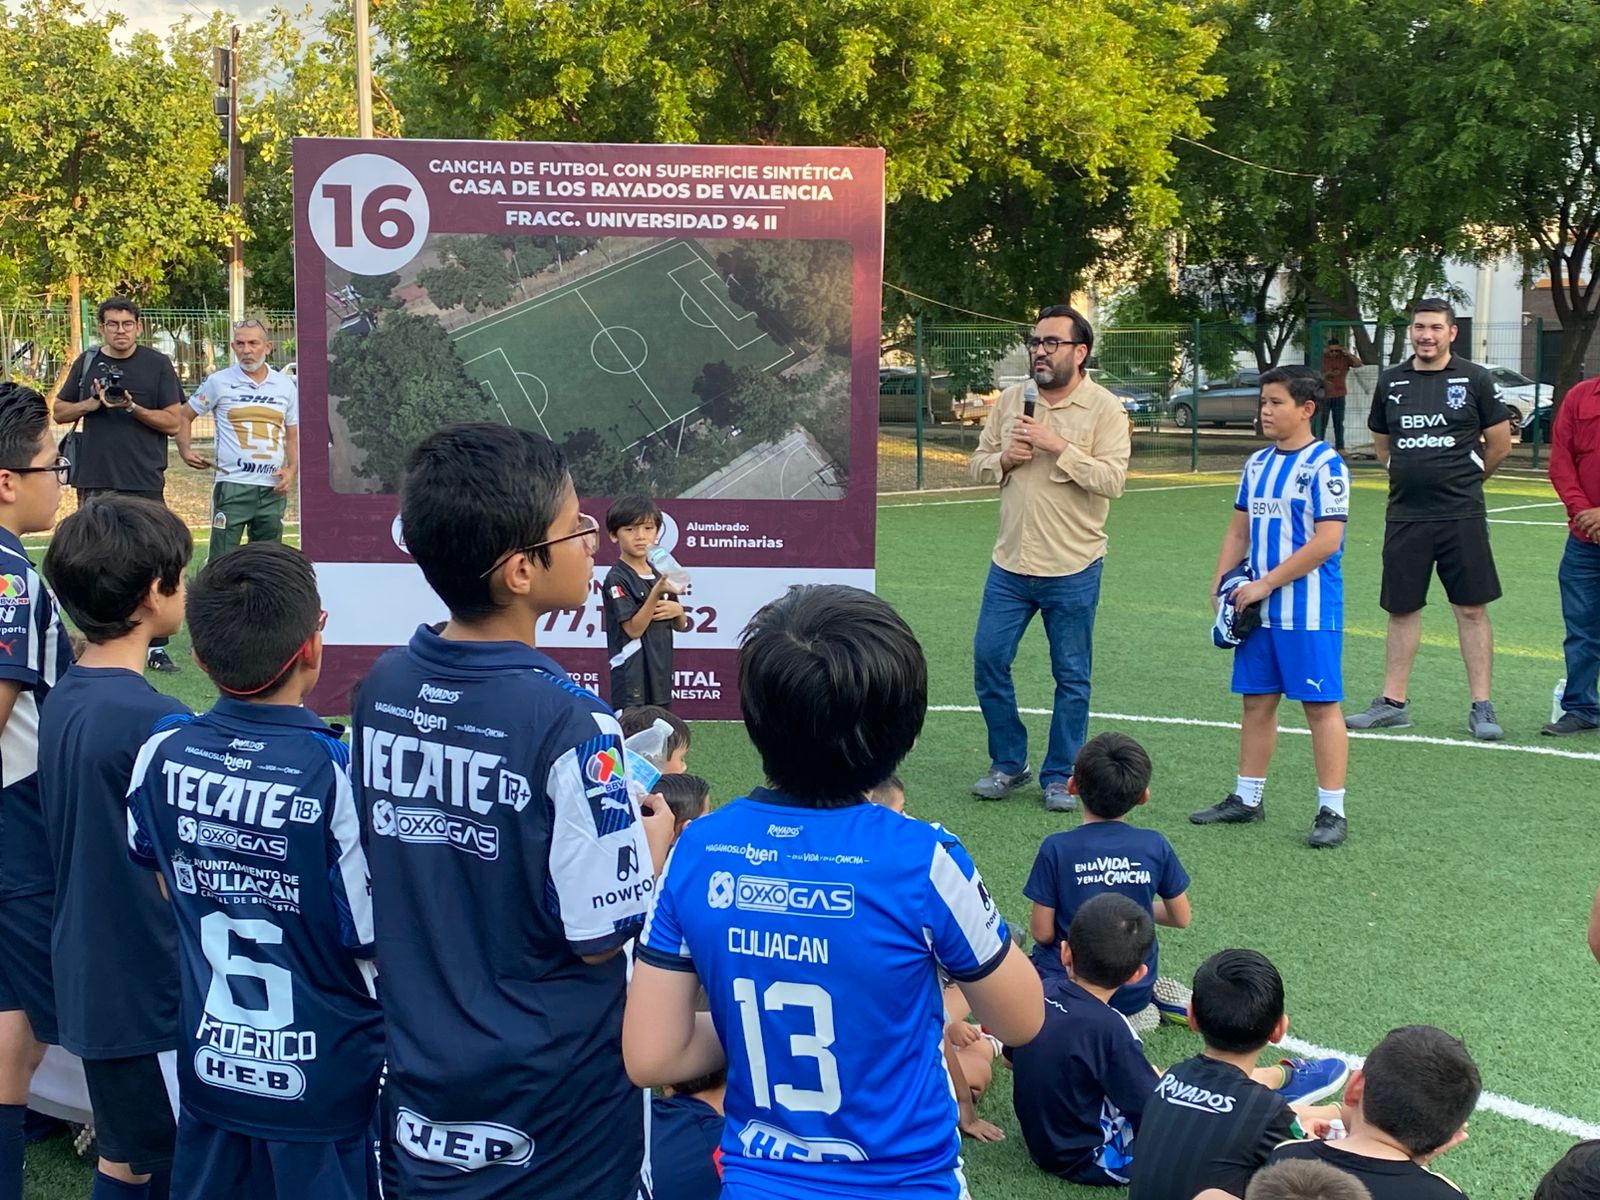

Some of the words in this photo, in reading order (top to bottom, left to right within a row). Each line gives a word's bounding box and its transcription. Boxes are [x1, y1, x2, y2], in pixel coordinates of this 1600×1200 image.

[429, 159, 505, 174] CANCHA
[510, 161, 534, 175] DE
[539, 162, 609, 177] FUTBOL
[613, 163, 651, 177] CON
[656, 164, 758, 179] SUPERFICIE
[762, 163, 853, 181] SINTÉTICA
[449, 179, 506, 195] CASA
[512, 180, 540, 196] DE
[546, 181, 586, 197] LOS
[591, 182, 691, 198] RAYADOS
[696, 184, 724, 199] DE
[729, 185, 833, 201] VALENCIA
[321, 184, 415, 250] 16
[506, 210, 581, 227] FRACC.
[586, 212, 727, 229] UNIVERSIDAD
[732, 214, 760, 230] 94
[764, 215, 777, 230] II
[239, 394, 277, 404] DHL
[1401, 413, 1448, 429] BBVA
[1397, 434, 1456, 449] codere
[1253, 502, 1281, 515] BBVA
[686, 522, 750, 532] Alumbrado:
[686, 536, 697, 548] 8
[700, 535, 784, 548] Luminarias
[0, 626, 27, 636] ports
[584, 673, 599, 682] DE
[672, 671, 721, 687] ITAL
[418, 683, 461, 704] RAYADOS
[671, 689, 721, 700] NESTAR
[161, 759, 297, 829] TECATE
[293, 797, 321, 821] 18+
[767, 824, 800, 838] RAYADOS
[193, 858, 281, 879] AYUNTAMIENTO
[282, 873, 299, 885] DE
[1075, 863, 1087, 873] EN
[1087, 862, 1098, 871] LA
[1097, 856, 1130, 872] VIDA
[197, 870, 299, 904] CULIACÁN
[1077, 876, 1083, 885] Y
[1083, 876, 1094, 885] EN
[1094, 875, 1104, 883] LA
[1104, 870, 1151, 886] CANCHA
[233, 896, 247, 904] DE
[592, 874, 655, 909] nowpo
[728, 927, 829, 964] CULIACAN
[201, 911, 294, 1031] 6
[195, 1013, 316, 1061] FEDERICO
[733, 977, 842, 1116] 13
[1155, 1073, 1237, 1114] RAYADOS
